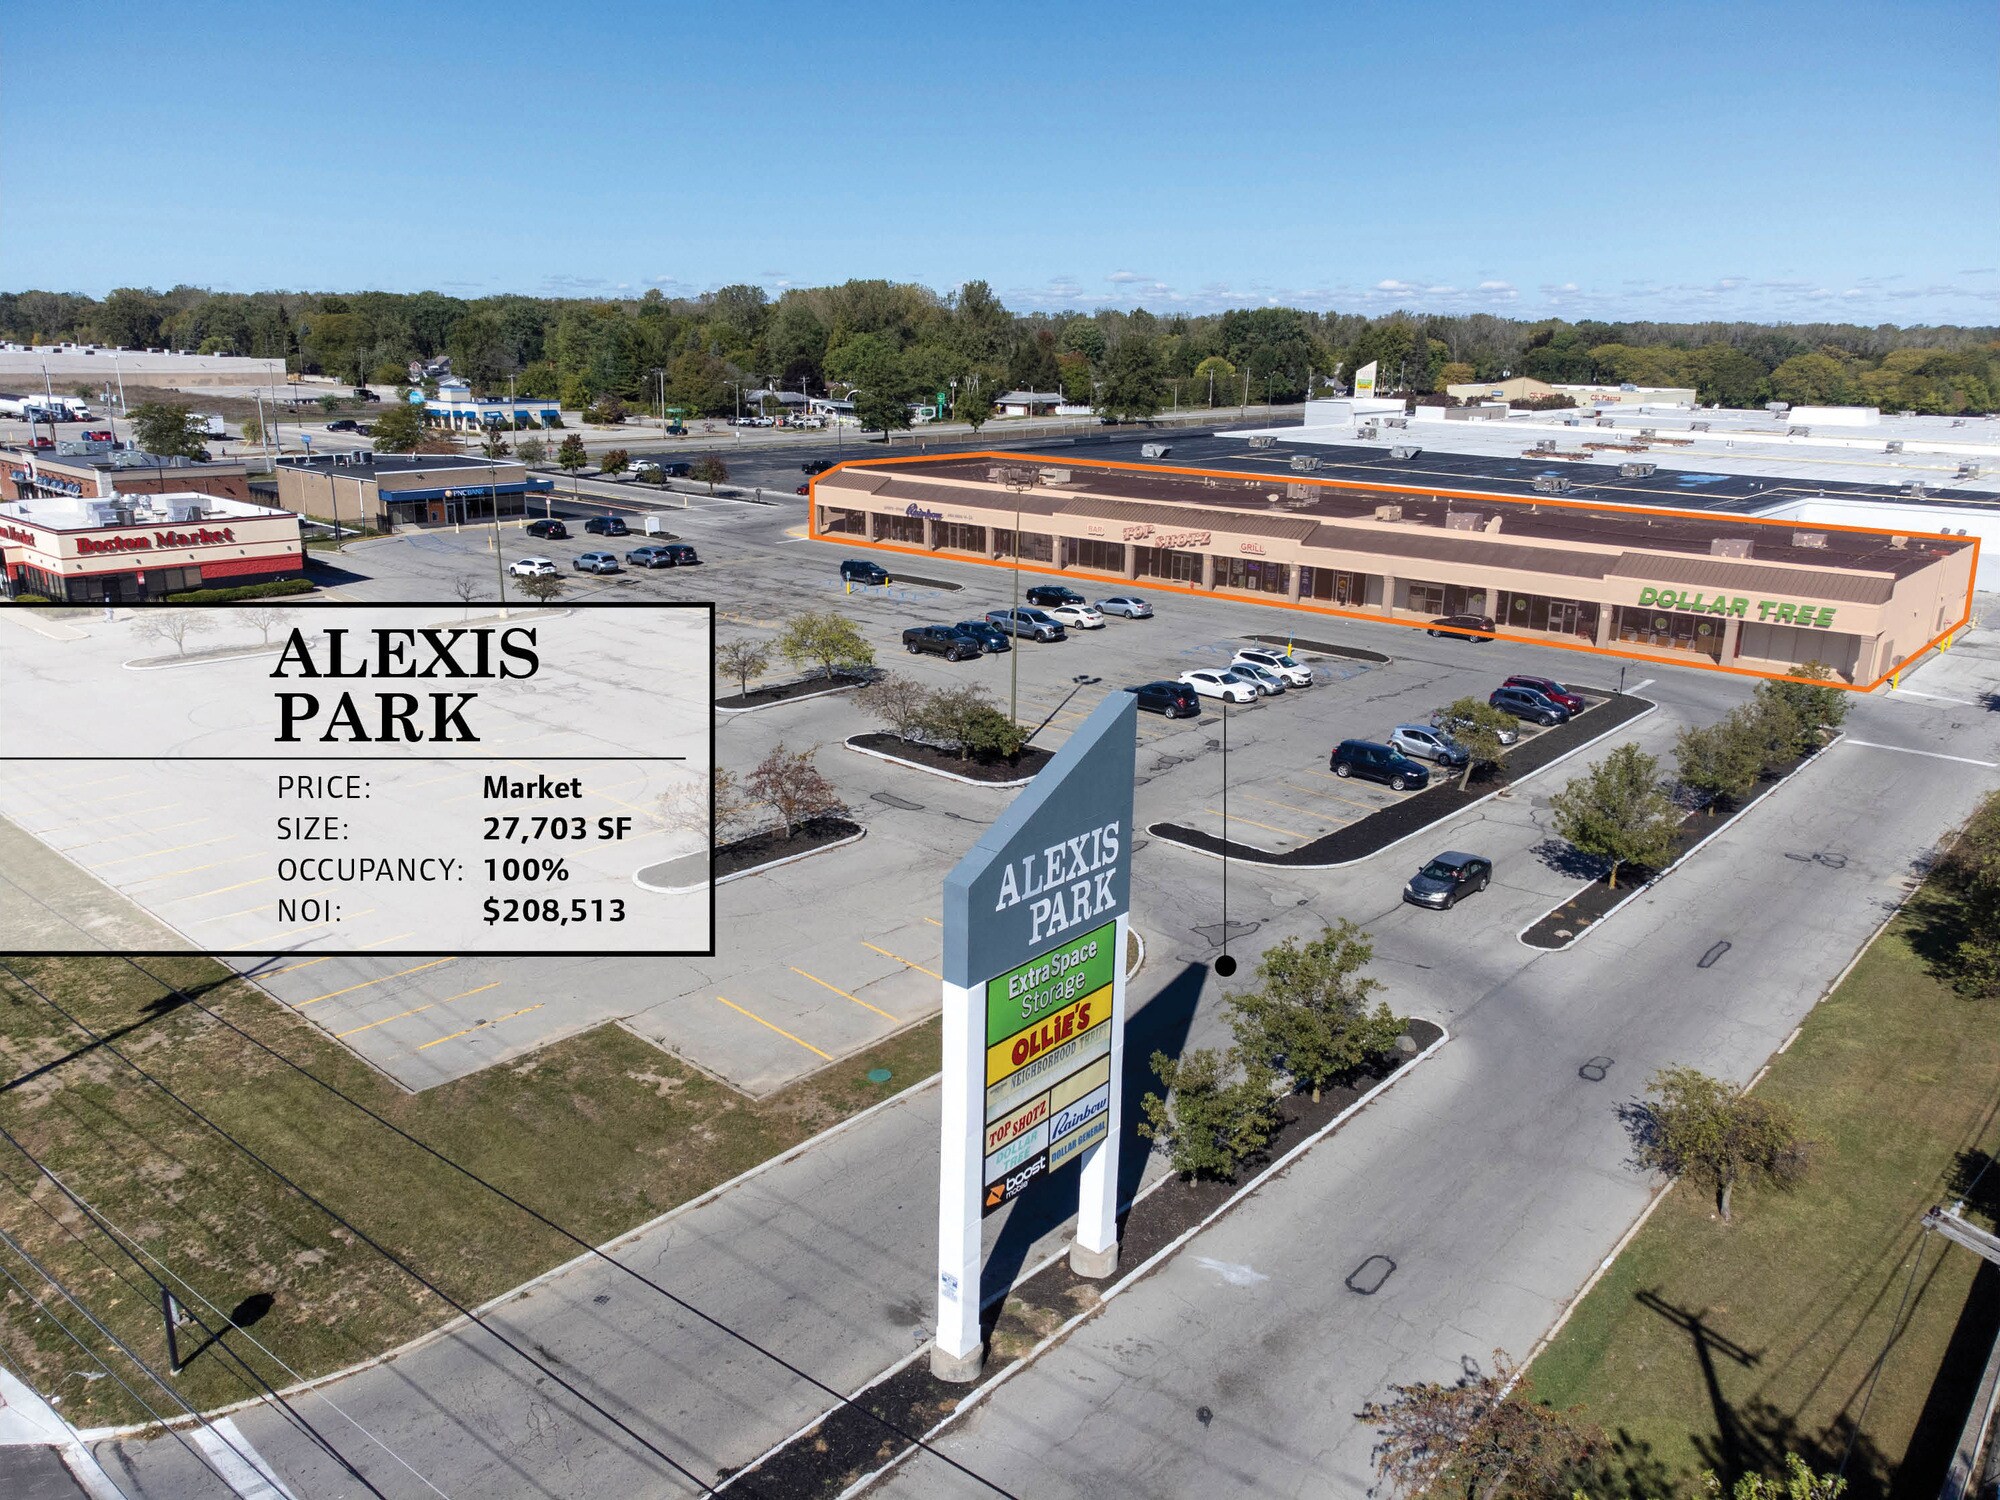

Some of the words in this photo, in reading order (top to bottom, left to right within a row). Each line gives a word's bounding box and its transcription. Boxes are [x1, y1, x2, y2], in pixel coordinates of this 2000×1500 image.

[75, 536, 152, 555] Boston
[153, 527, 236, 549] Market
[1087, 525, 1105, 535] BAR
[1122, 524, 1155, 541] TOP
[1154, 531, 1212, 549] SHOTZ
[1240, 542, 1266, 554] GRILL
[1638, 586, 1750, 618] DOLLAR
[1757, 600, 1837, 628] TREE
[995, 820, 1119, 912] ALEXIS
[1028, 867, 1117, 946] PARK
[1021, 971, 1085, 1018] Storage
[1010, 1041, 1077, 1088] NEIGHBORHOOD
[989, 1120, 1012, 1148] TOP
[1012, 1099, 1047, 1137] SHOTZ
[1052, 1098, 1107, 1140] Rainbow
[996, 1130, 1038, 1164] DOLLAR
[1003, 1147, 1031, 1171] TREE
[1051, 1138, 1077, 1163] DOLLAR
[1077, 1120, 1106, 1146] GENERAL
[1006, 1155, 1046, 1191] boost
[1006, 1180, 1029, 1199] mobile
